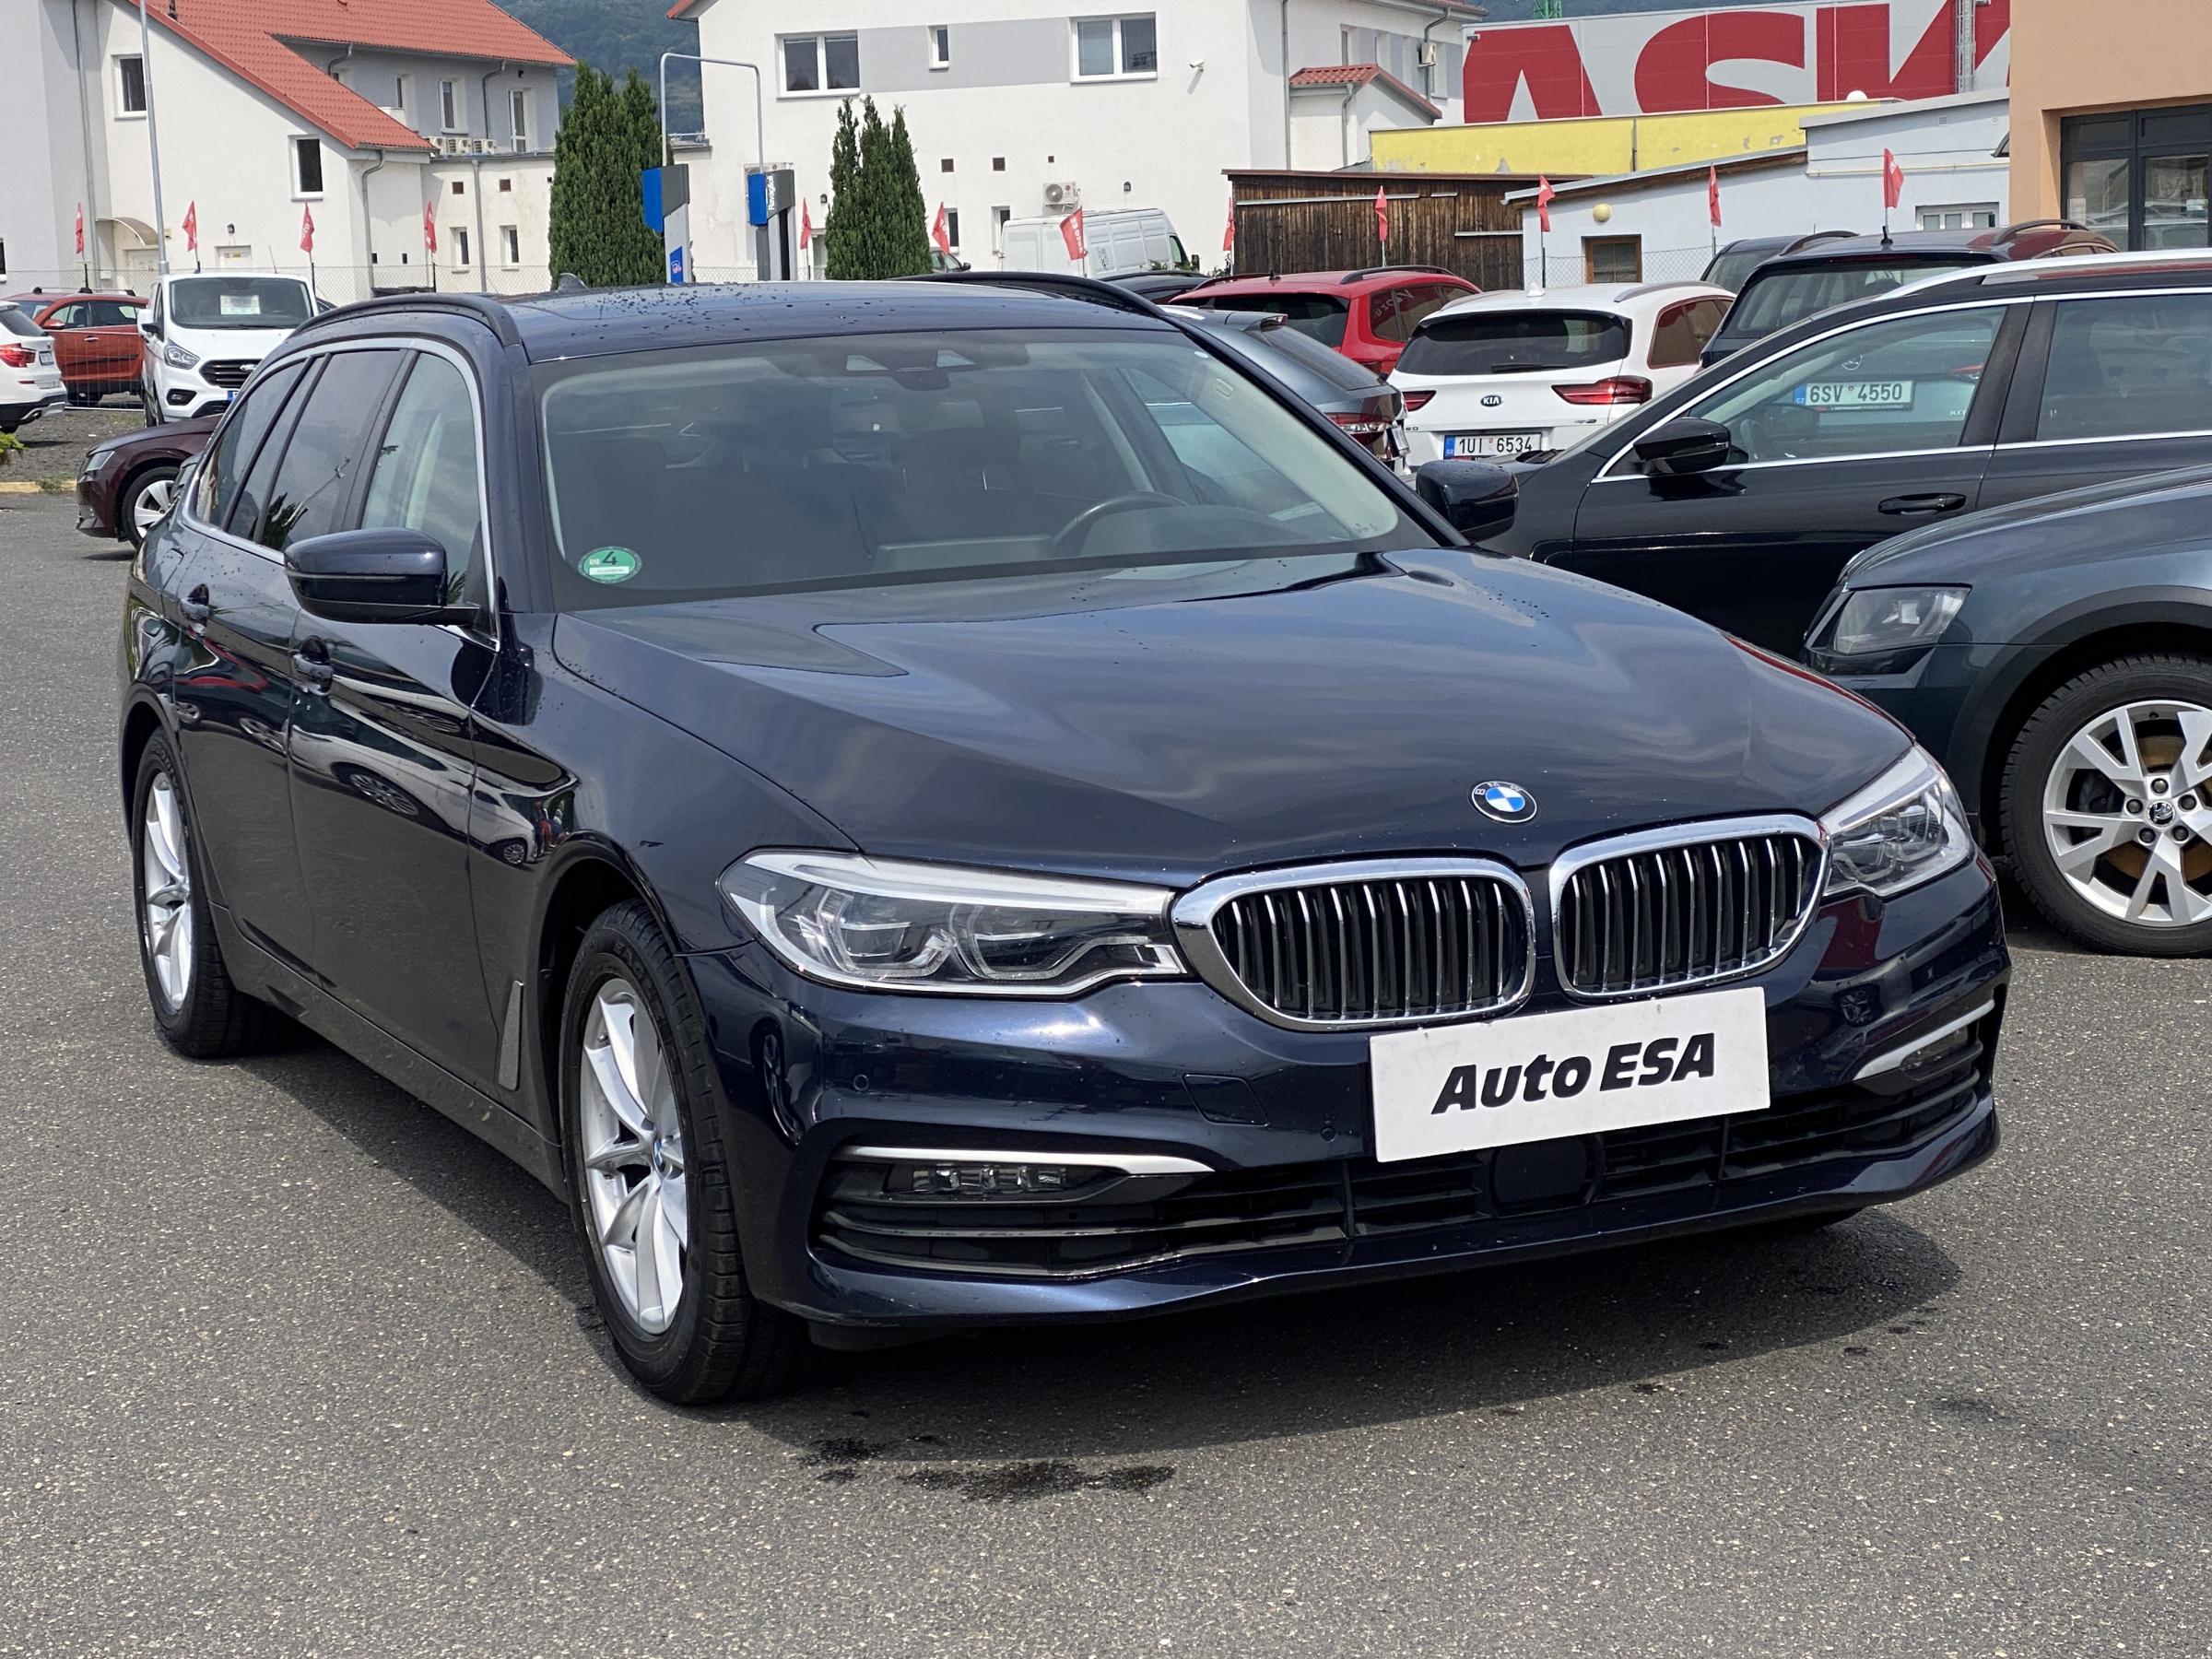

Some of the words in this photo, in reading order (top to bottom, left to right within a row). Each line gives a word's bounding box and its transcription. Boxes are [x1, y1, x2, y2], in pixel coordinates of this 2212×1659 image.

[1464, 0, 2010, 124] ASK
[1483, 396, 1500, 405] KIA
[1810, 384, 1843, 403] 6SV
[1857, 382, 1903, 402] 4550
[1459, 437, 1482, 453] 1UI
[1496, 436, 1533, 453] 6534
[602, 550, 618, 565] 4
[1430, 1053, 1593, 1115] Auto
[1599, 1032, 1715, 1092] ESA
